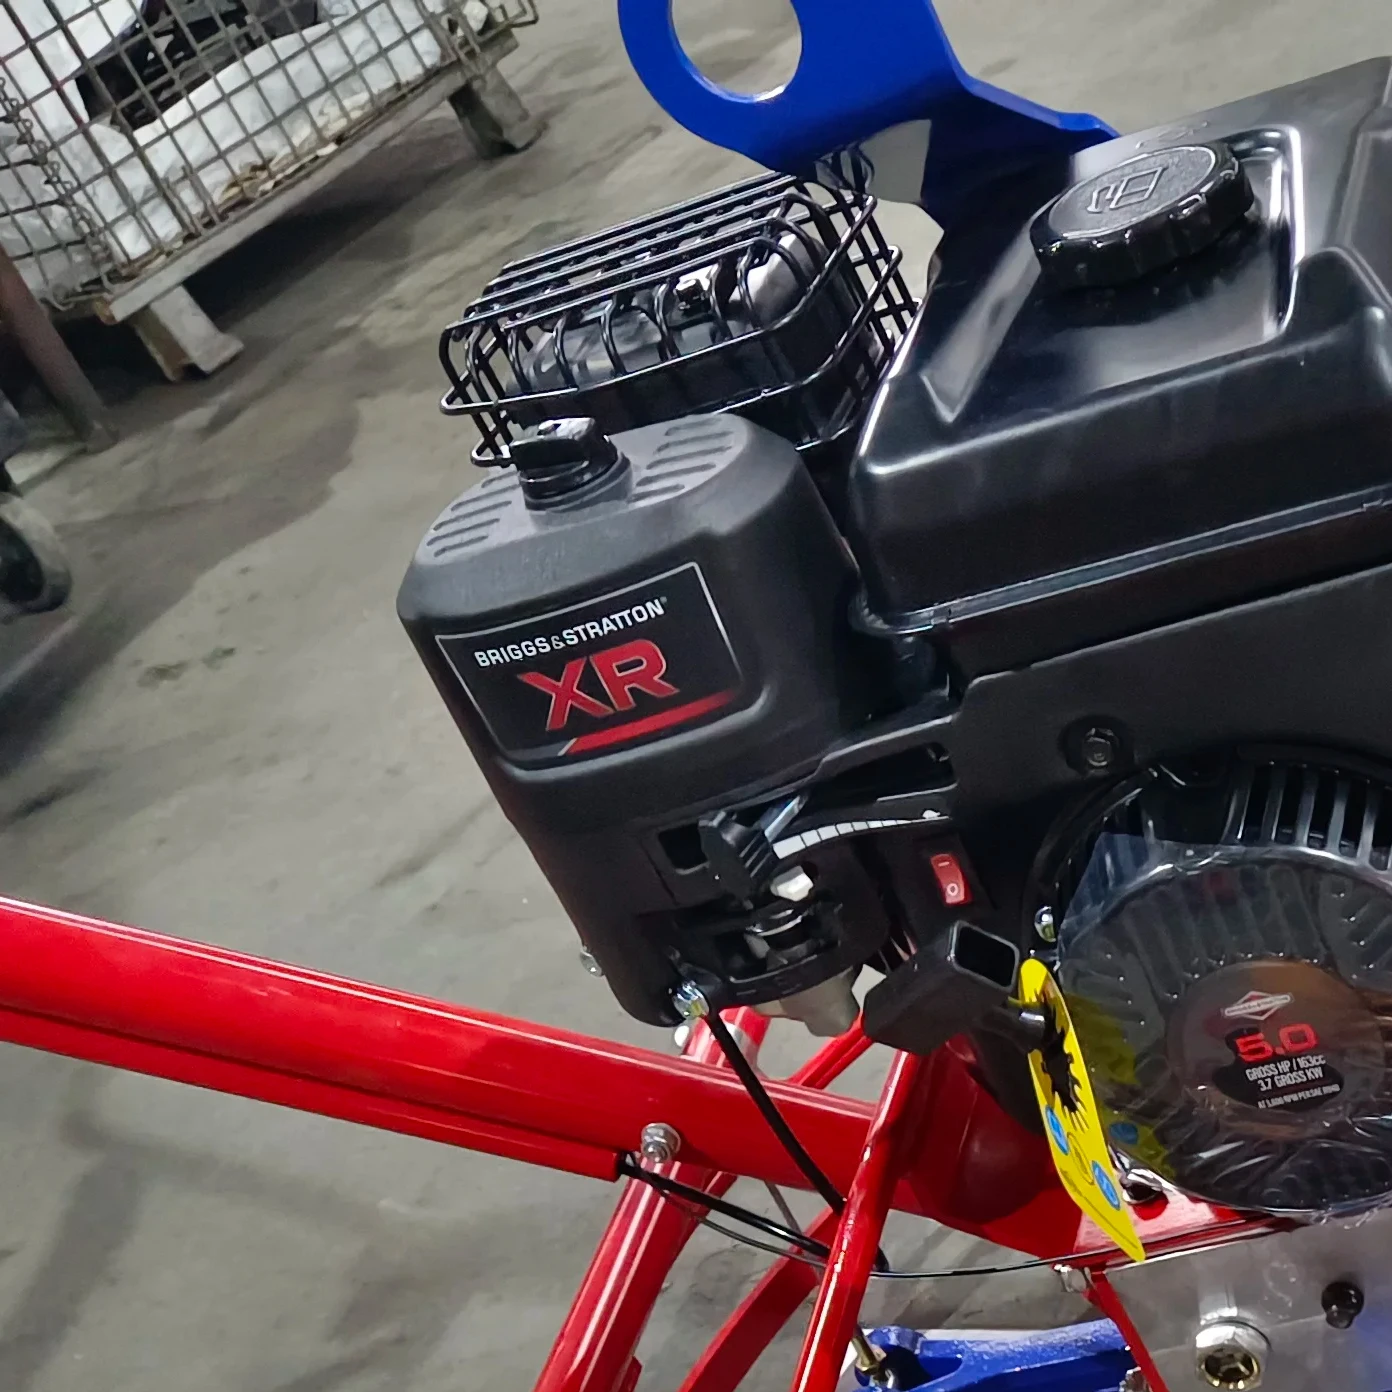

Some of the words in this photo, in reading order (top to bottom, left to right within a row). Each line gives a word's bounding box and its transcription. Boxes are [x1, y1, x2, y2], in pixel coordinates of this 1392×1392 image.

[517, 639, 680, 731] XR
[1235, 1023, 1319, 1063] 5.0
[1245, 1063, 1279, 1081] GROSS
[1277, 1060, 1291, 1073] HP
[1297, 1054, 1327, 1069] 163cc
[1257, 1077, 1272, 1092] 3.7
[1274, 1070, 1308, 1087] GROSS
[1305, 1066, 1323, 1080] KW
